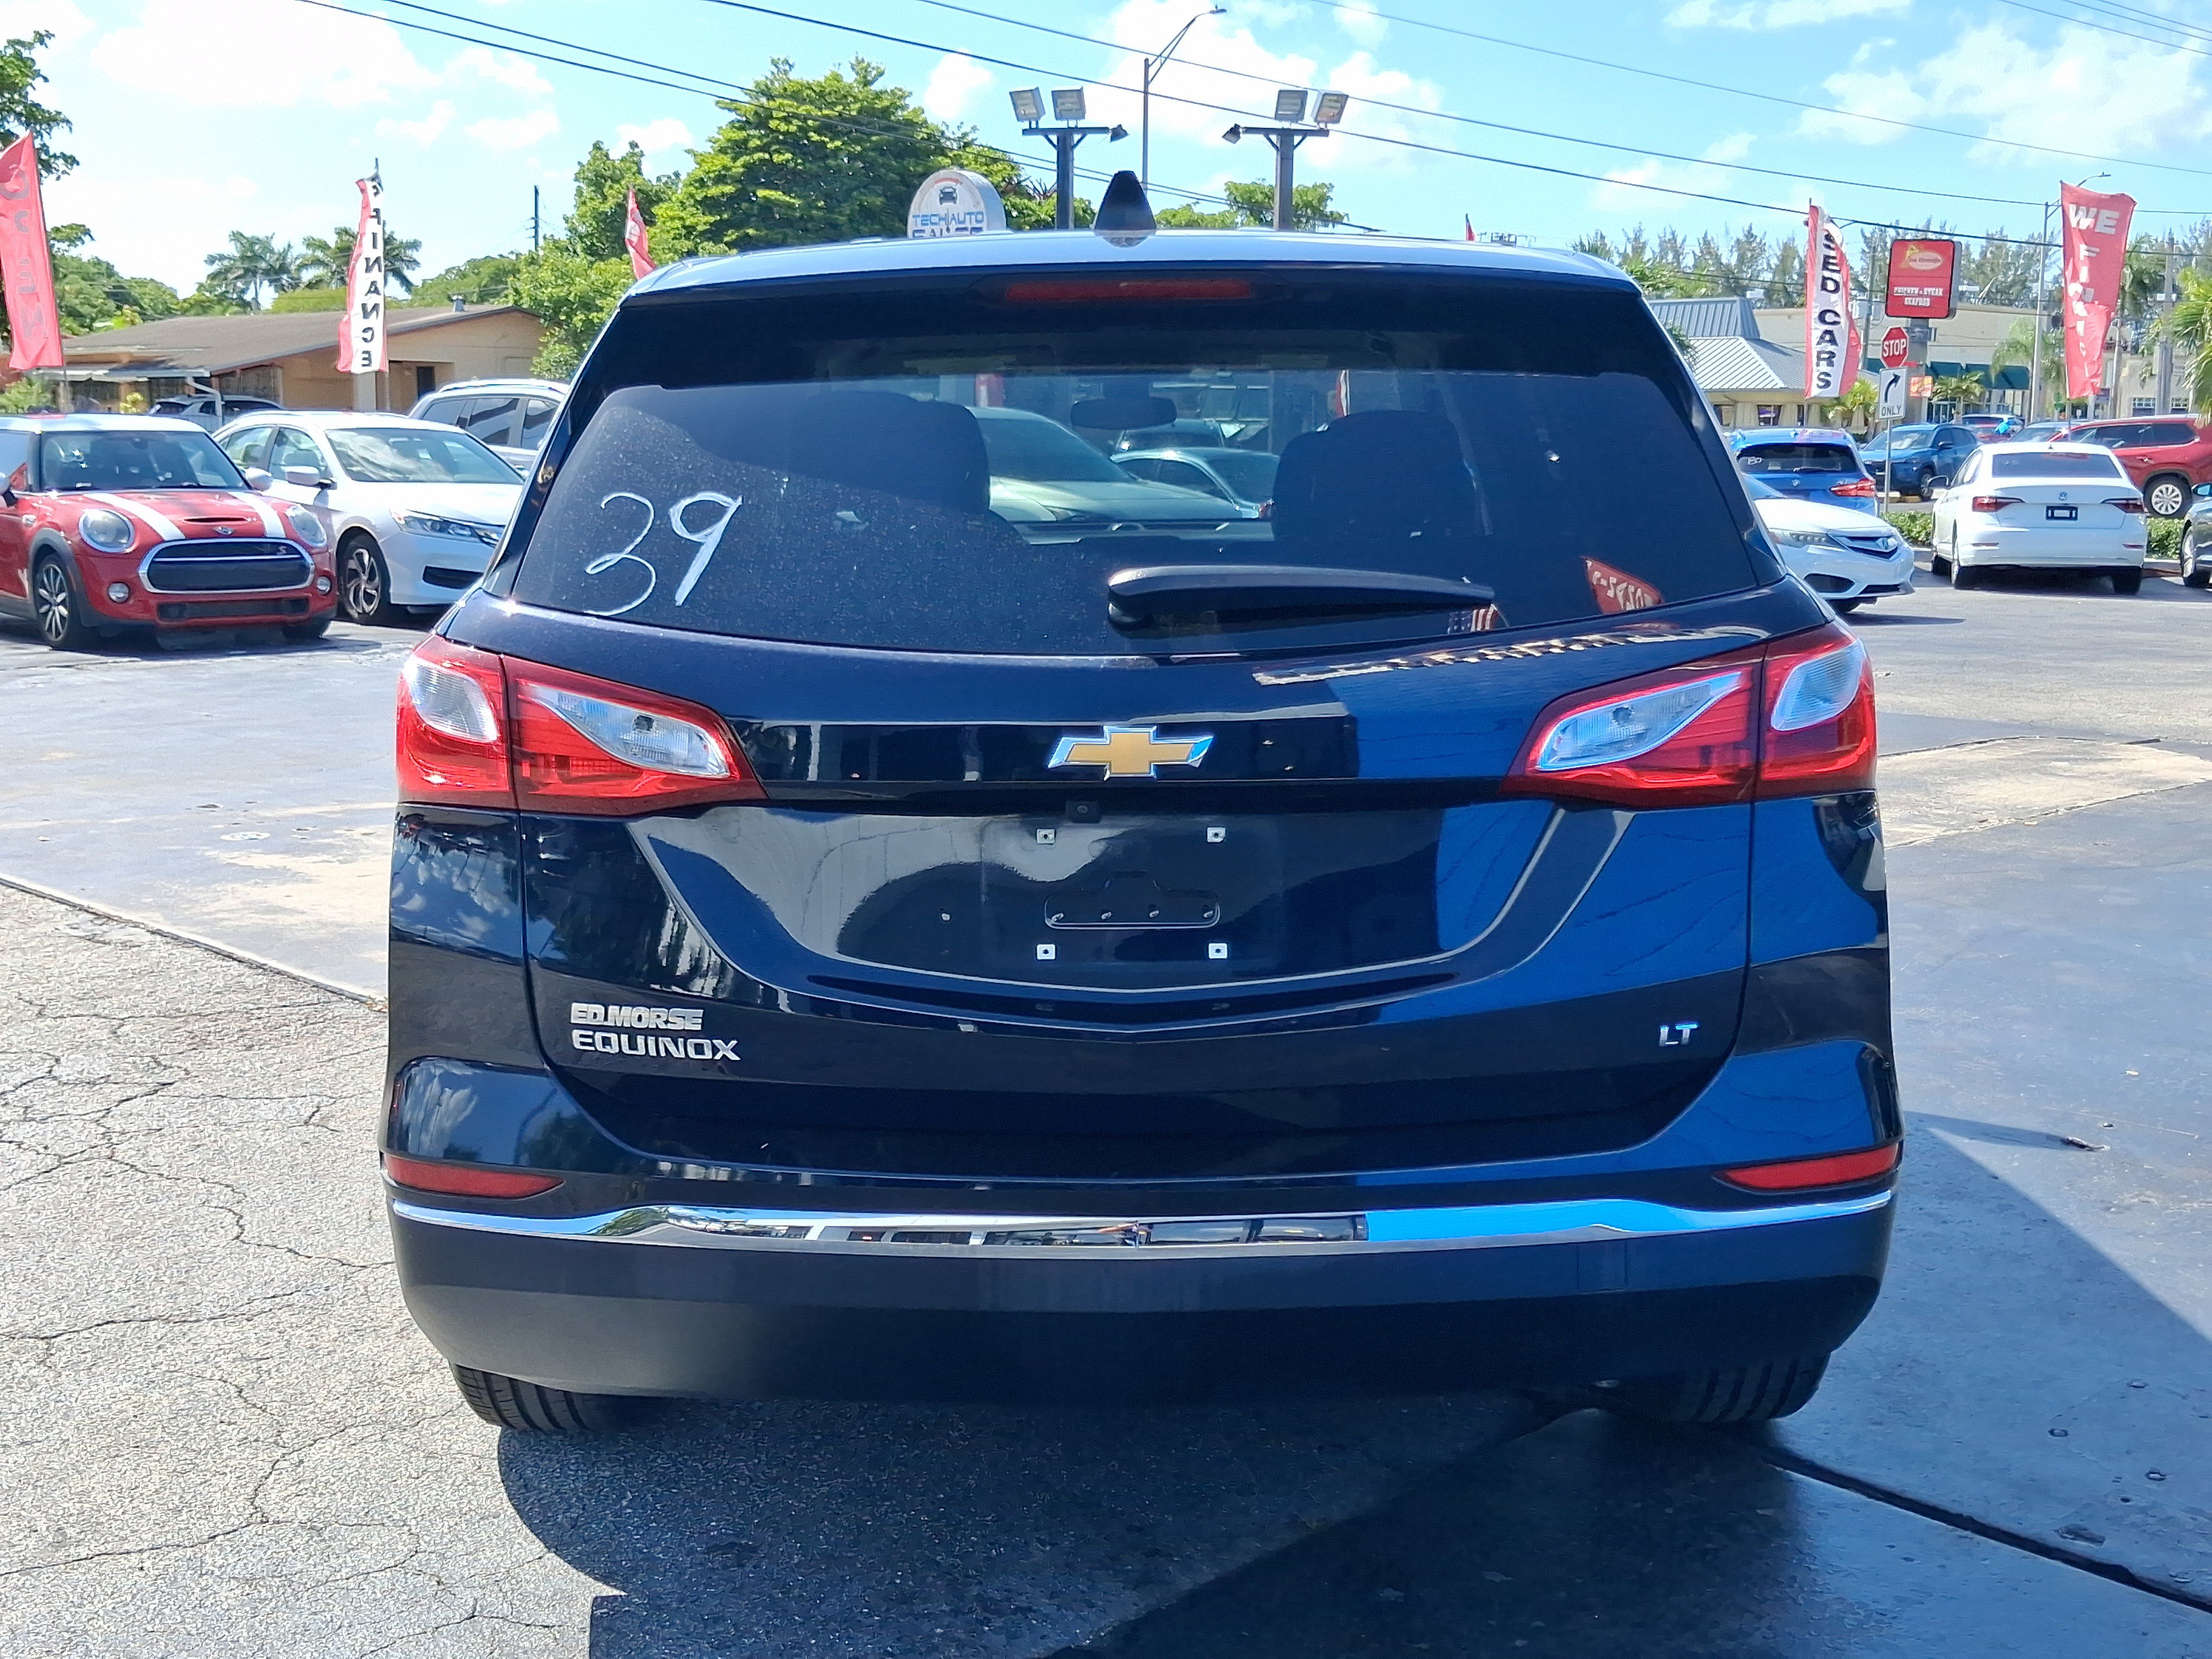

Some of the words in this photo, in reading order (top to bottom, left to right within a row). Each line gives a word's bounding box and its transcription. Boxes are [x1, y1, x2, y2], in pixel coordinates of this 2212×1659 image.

[2068, 203, 2119, 235] WE
[1816, 308, 1842, 390] CARS
[1883, 338, 1906, 357] STOP
[1881, 404, 1902, 416] ONLY
[583, 491, 742, 616] 39
[571, 1030, 741, 1060] EQUINOX
[1659, 1023, 1699, 1047] LT
